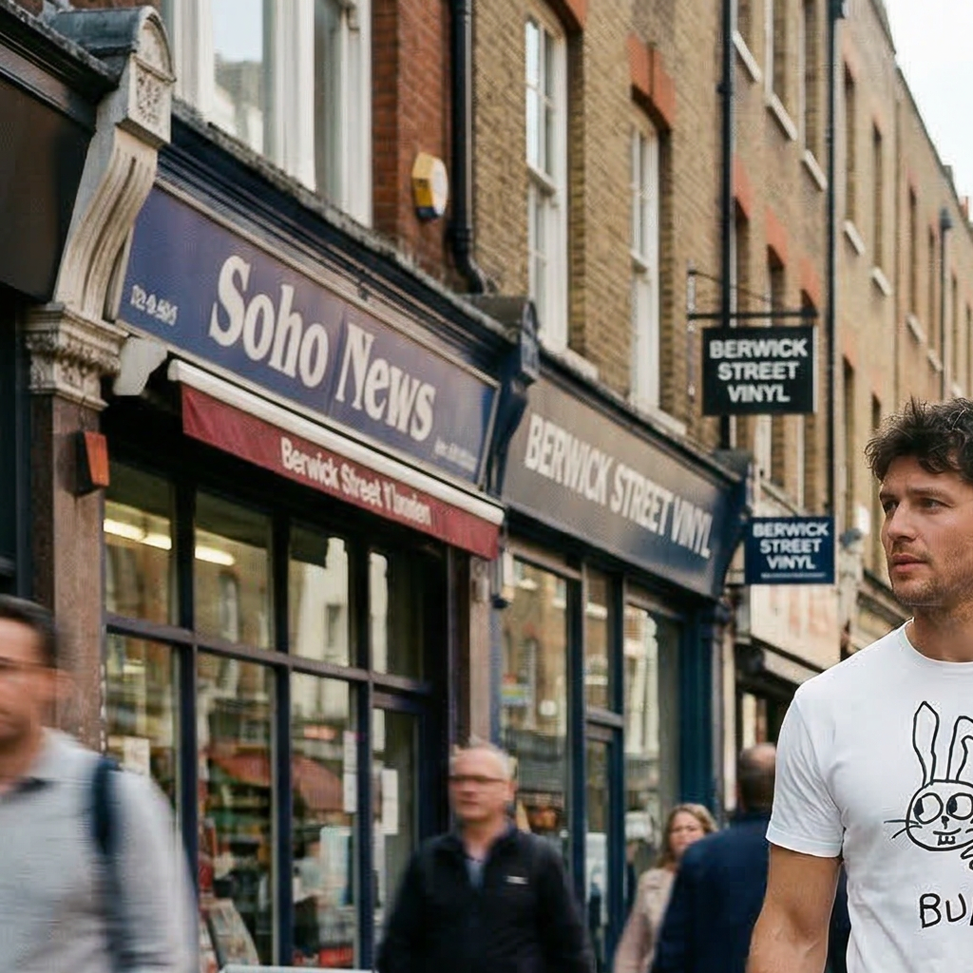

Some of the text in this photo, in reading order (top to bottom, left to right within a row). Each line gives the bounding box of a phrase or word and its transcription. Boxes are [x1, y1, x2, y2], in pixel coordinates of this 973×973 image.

[209, 255, 436, 442] Soho News
[709, 338, 808, 359] BERWICK
[718, 361, 800, 381] STREET
[727, 384, 790, 402] VINYL
[281, 437, 340, 490] Berwick
[340, 463, 383, 508] Street
[524, 413, 614, 506] BERWICK
[610, 463, 674, 536] STREET
[671, 495, 713, 560] VINYL
[753, 522, 829, 538] BERWICK
[760, 538, 822, 553] STREET
[766, 555, 816, 570] VINYL
